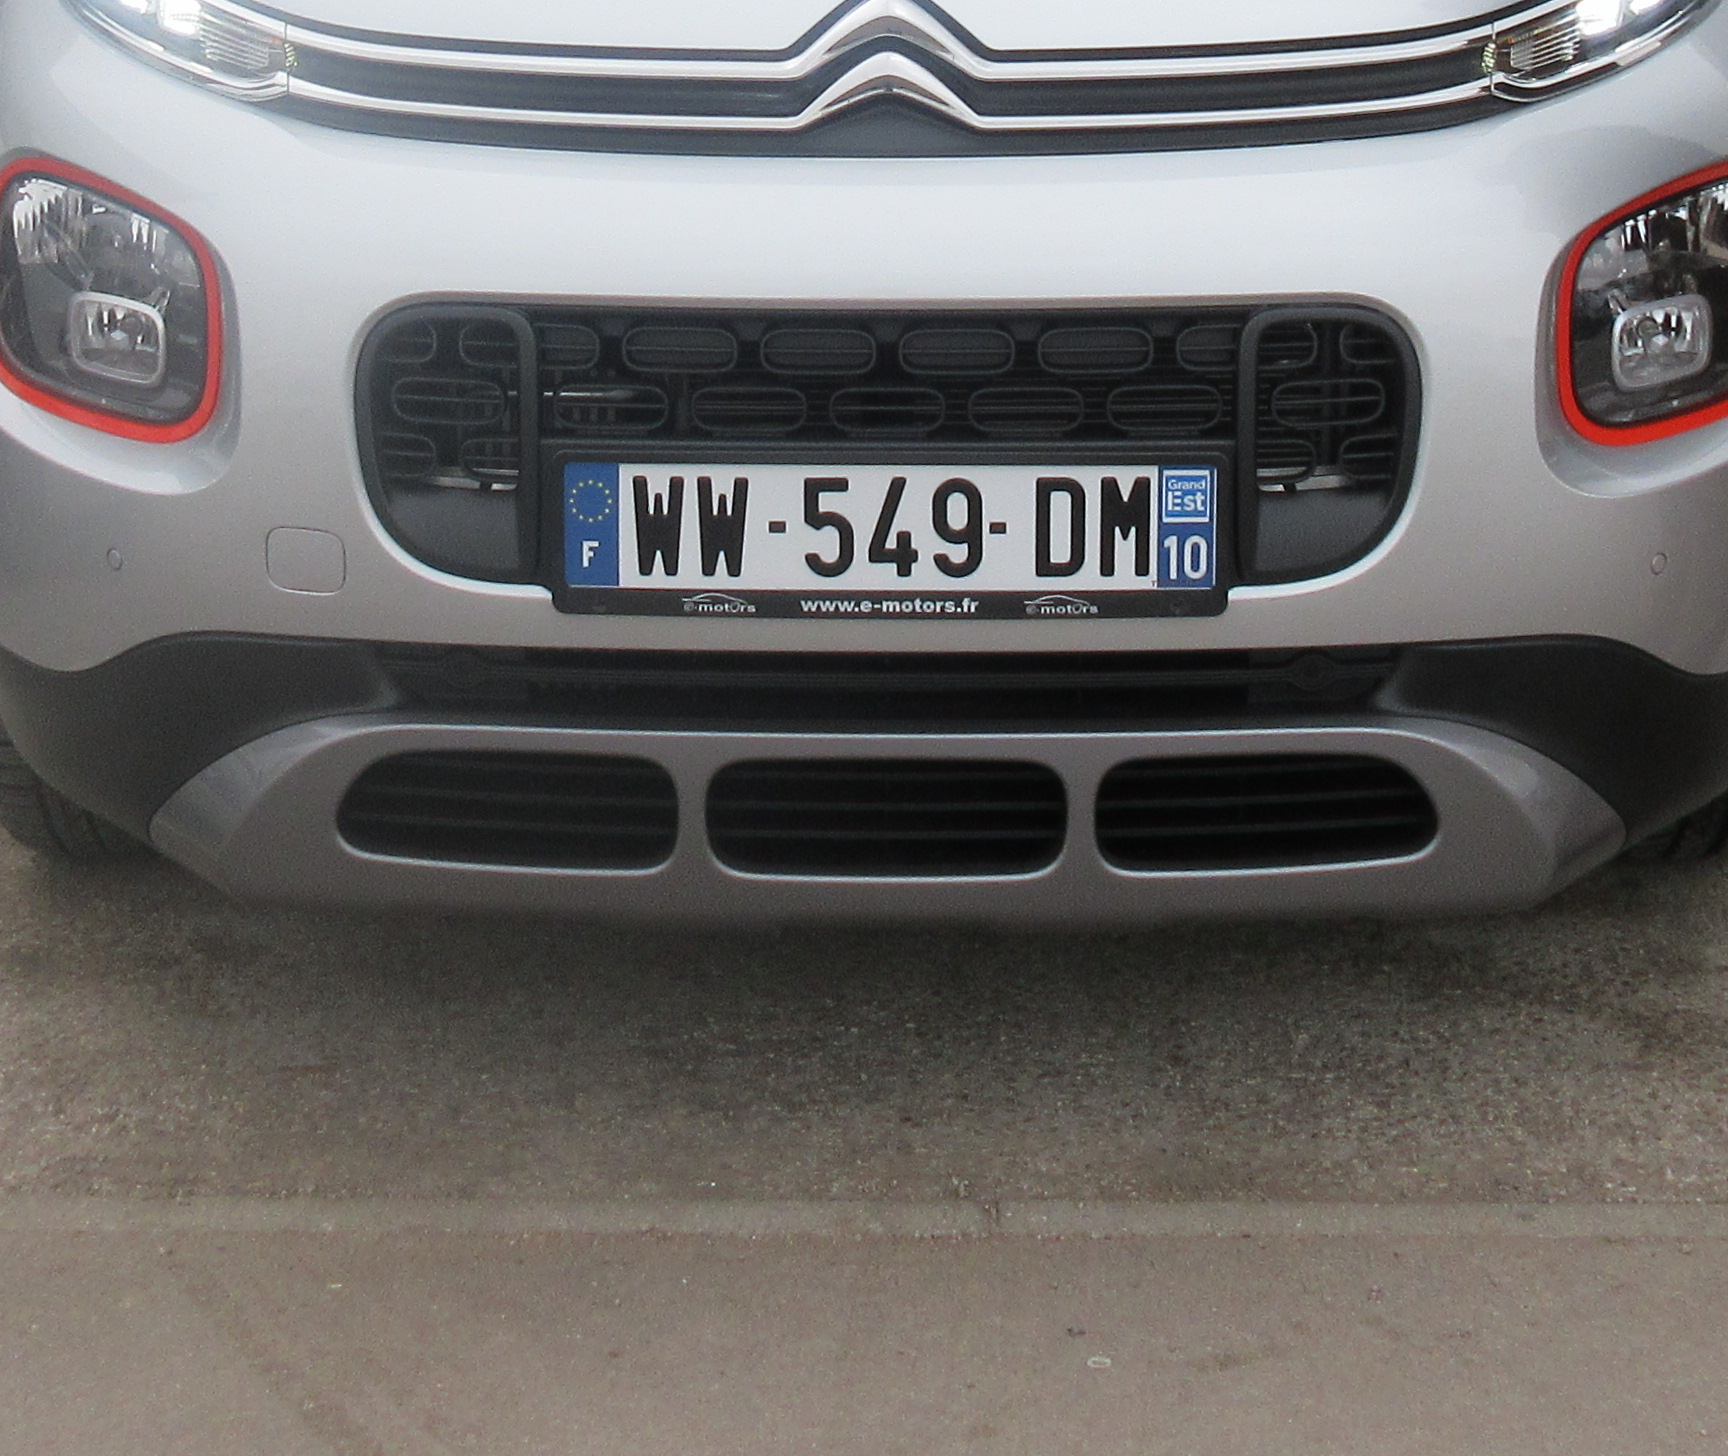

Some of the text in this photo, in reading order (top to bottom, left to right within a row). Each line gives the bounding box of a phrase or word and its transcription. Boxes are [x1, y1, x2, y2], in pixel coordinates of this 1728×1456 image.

[1167, 479, 1206, 490] Grand
[1167, 491, 1205, 511] Est
[632, 475, 1151, 578] WW-549-DM
[582, 540, 600, 568] F
[1163, 535, 1208, 580] 10
[800, 598, 979, 613] www.e-motors.fr
